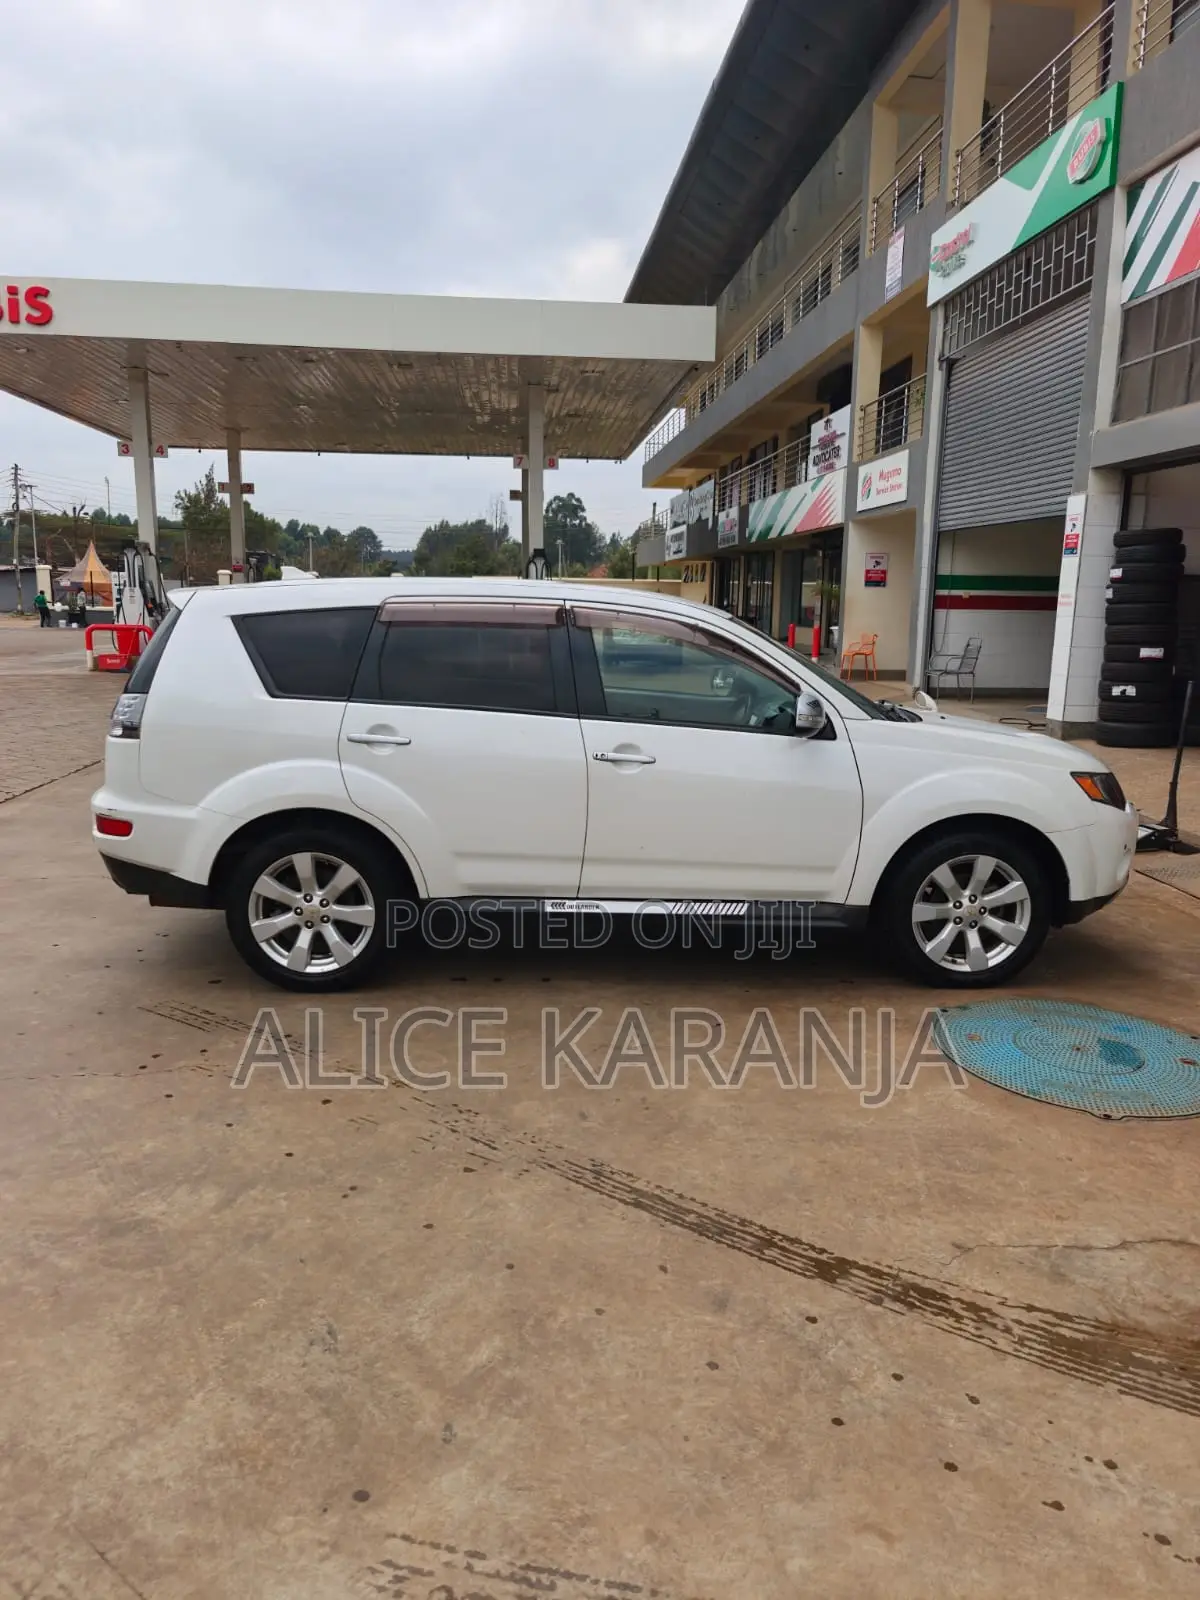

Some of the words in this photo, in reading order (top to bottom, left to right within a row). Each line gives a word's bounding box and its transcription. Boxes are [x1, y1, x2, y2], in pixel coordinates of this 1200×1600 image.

[0, 285, 53, 326] iS
[121, 443, 130, 454] 3
[155, 444, 165, 456] 4
[515, 456, 524, 466] 7
[548, 457, 556, 468] 8
